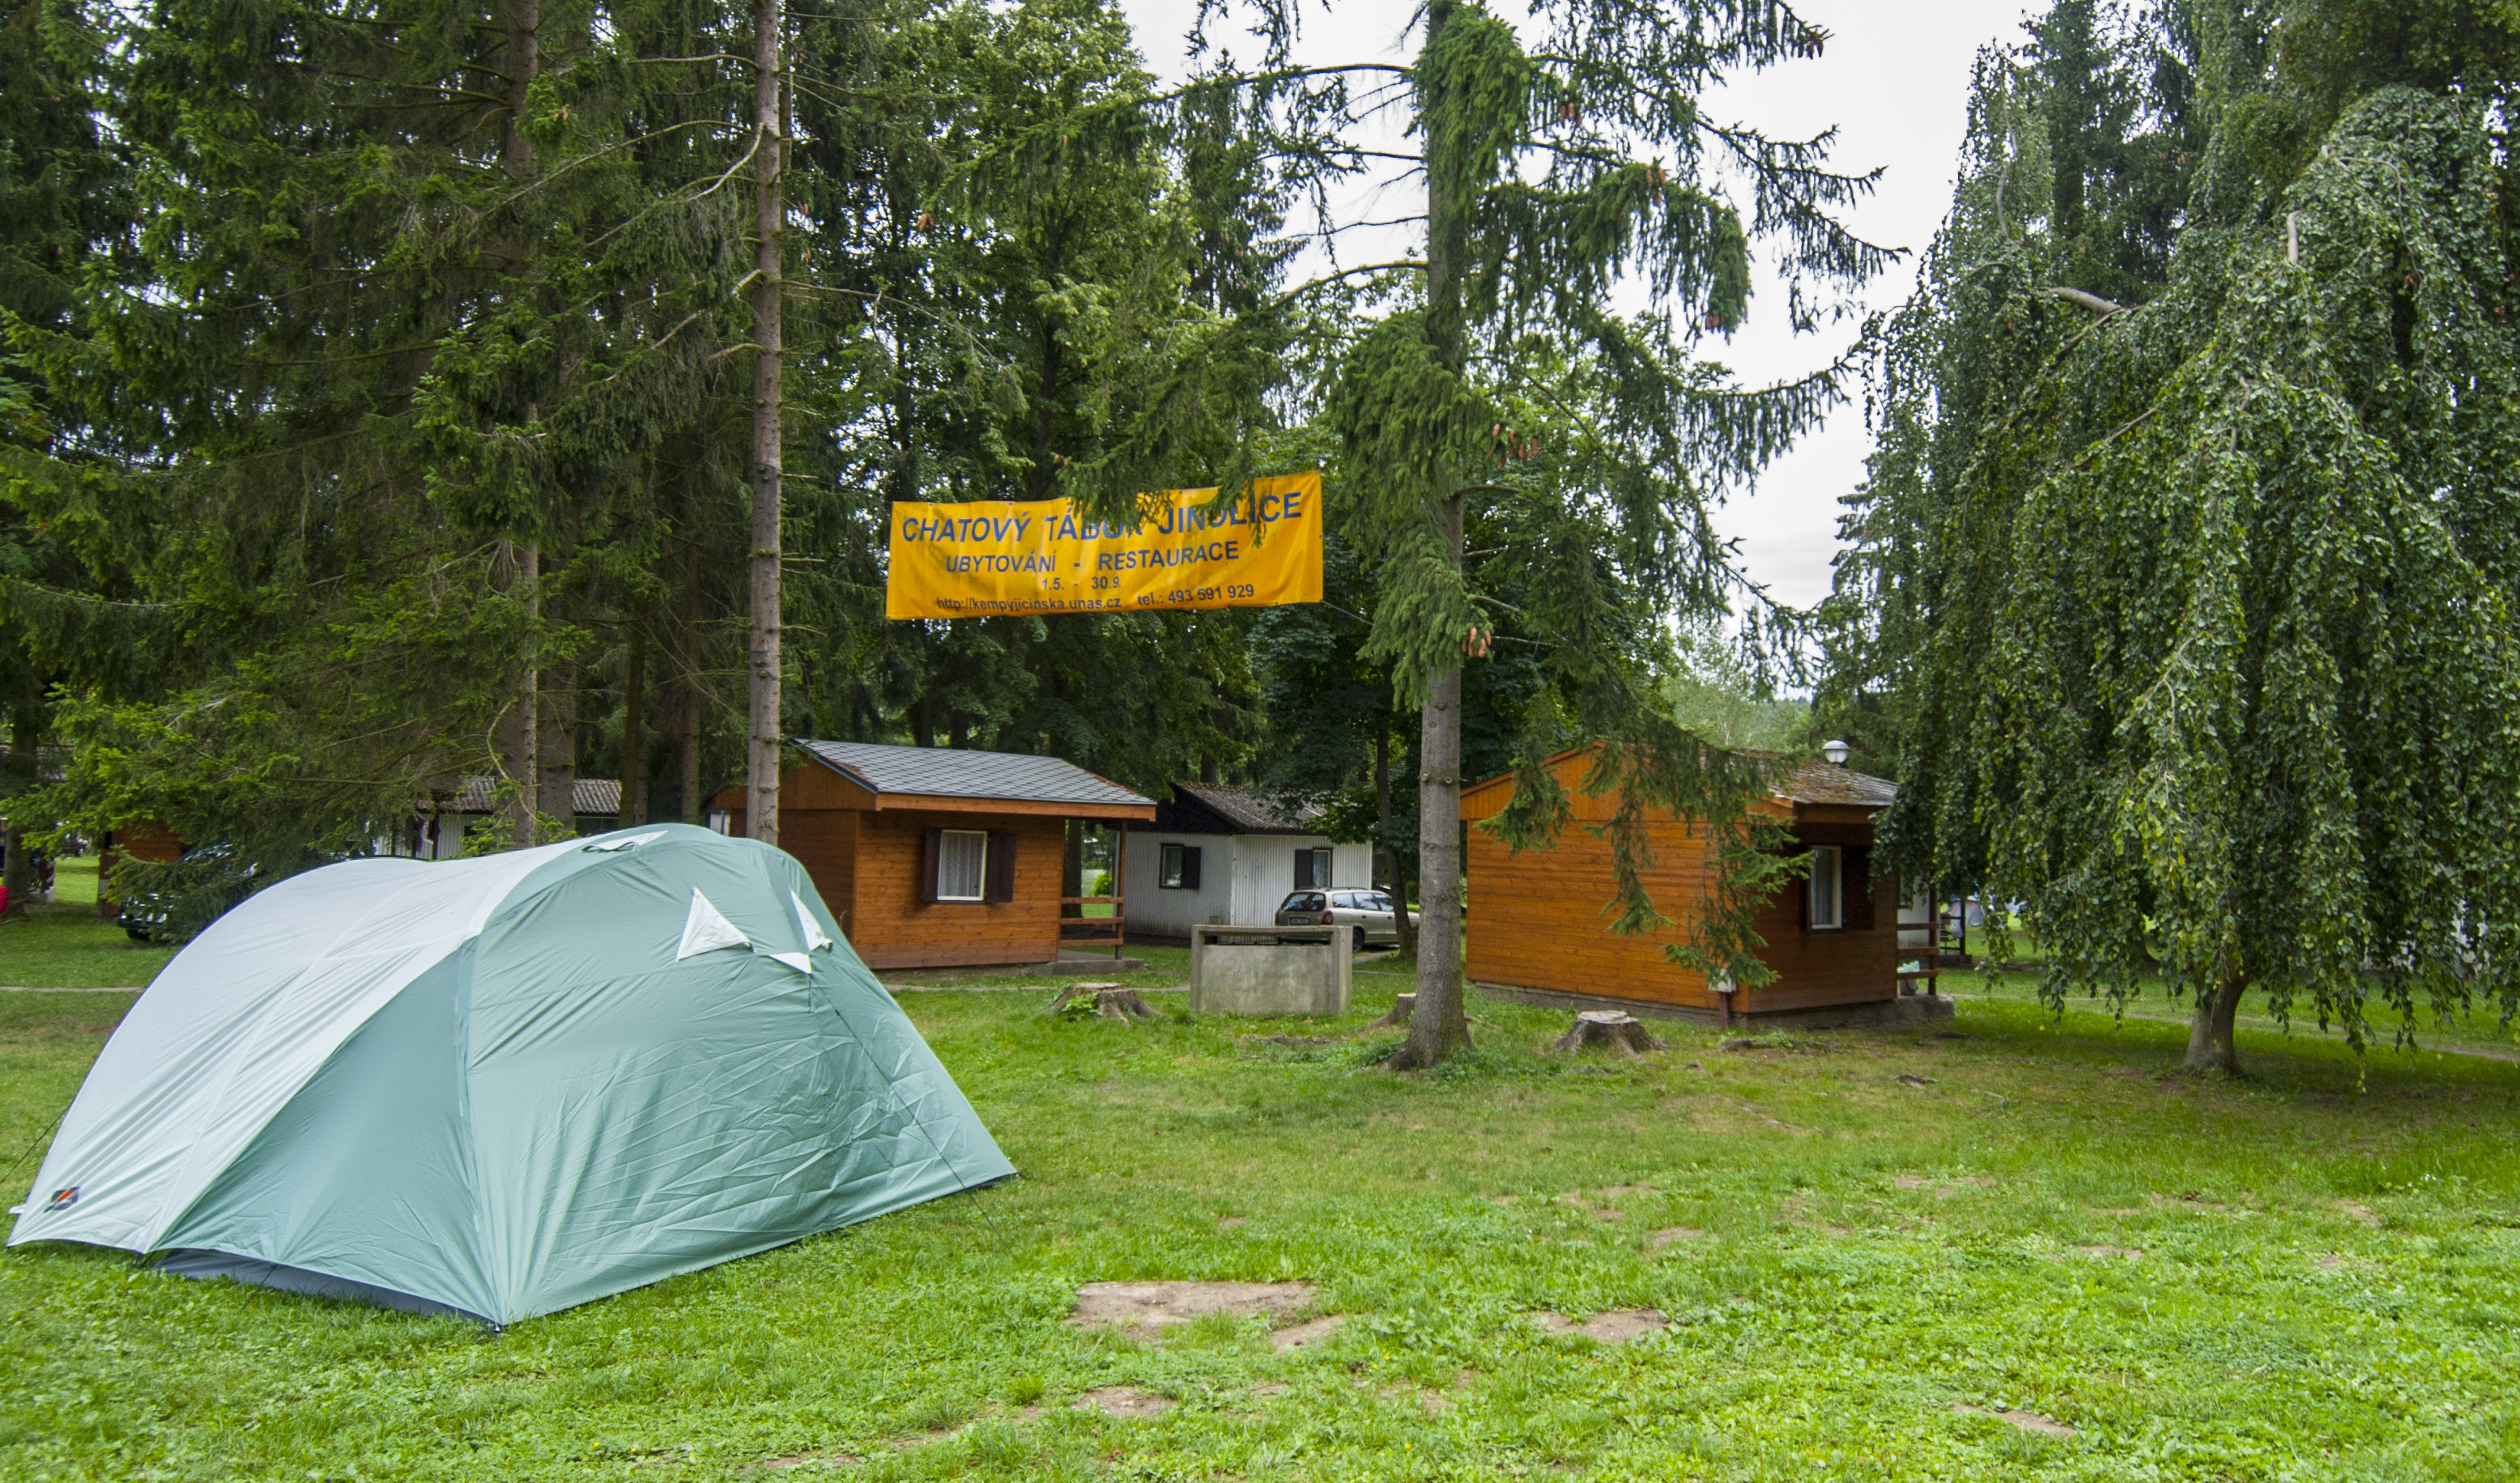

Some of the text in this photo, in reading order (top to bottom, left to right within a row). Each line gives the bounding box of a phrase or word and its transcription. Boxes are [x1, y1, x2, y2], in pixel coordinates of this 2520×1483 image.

[902, 512, 1032, 542] CHATOVÝ
[1045, 508, 1143, 540] TÁBO
[946, 550, 1057, 573] UBYTOVÁNÍ
[1098, 541, 1239, 571] RESTAURACE
[1042, 577, 1065, 591] 1.5.
[1168, 589, 1193, 603] 493
[1197, 586, 1221, 601] 591
[1227, 584, 1254, 598] 929
